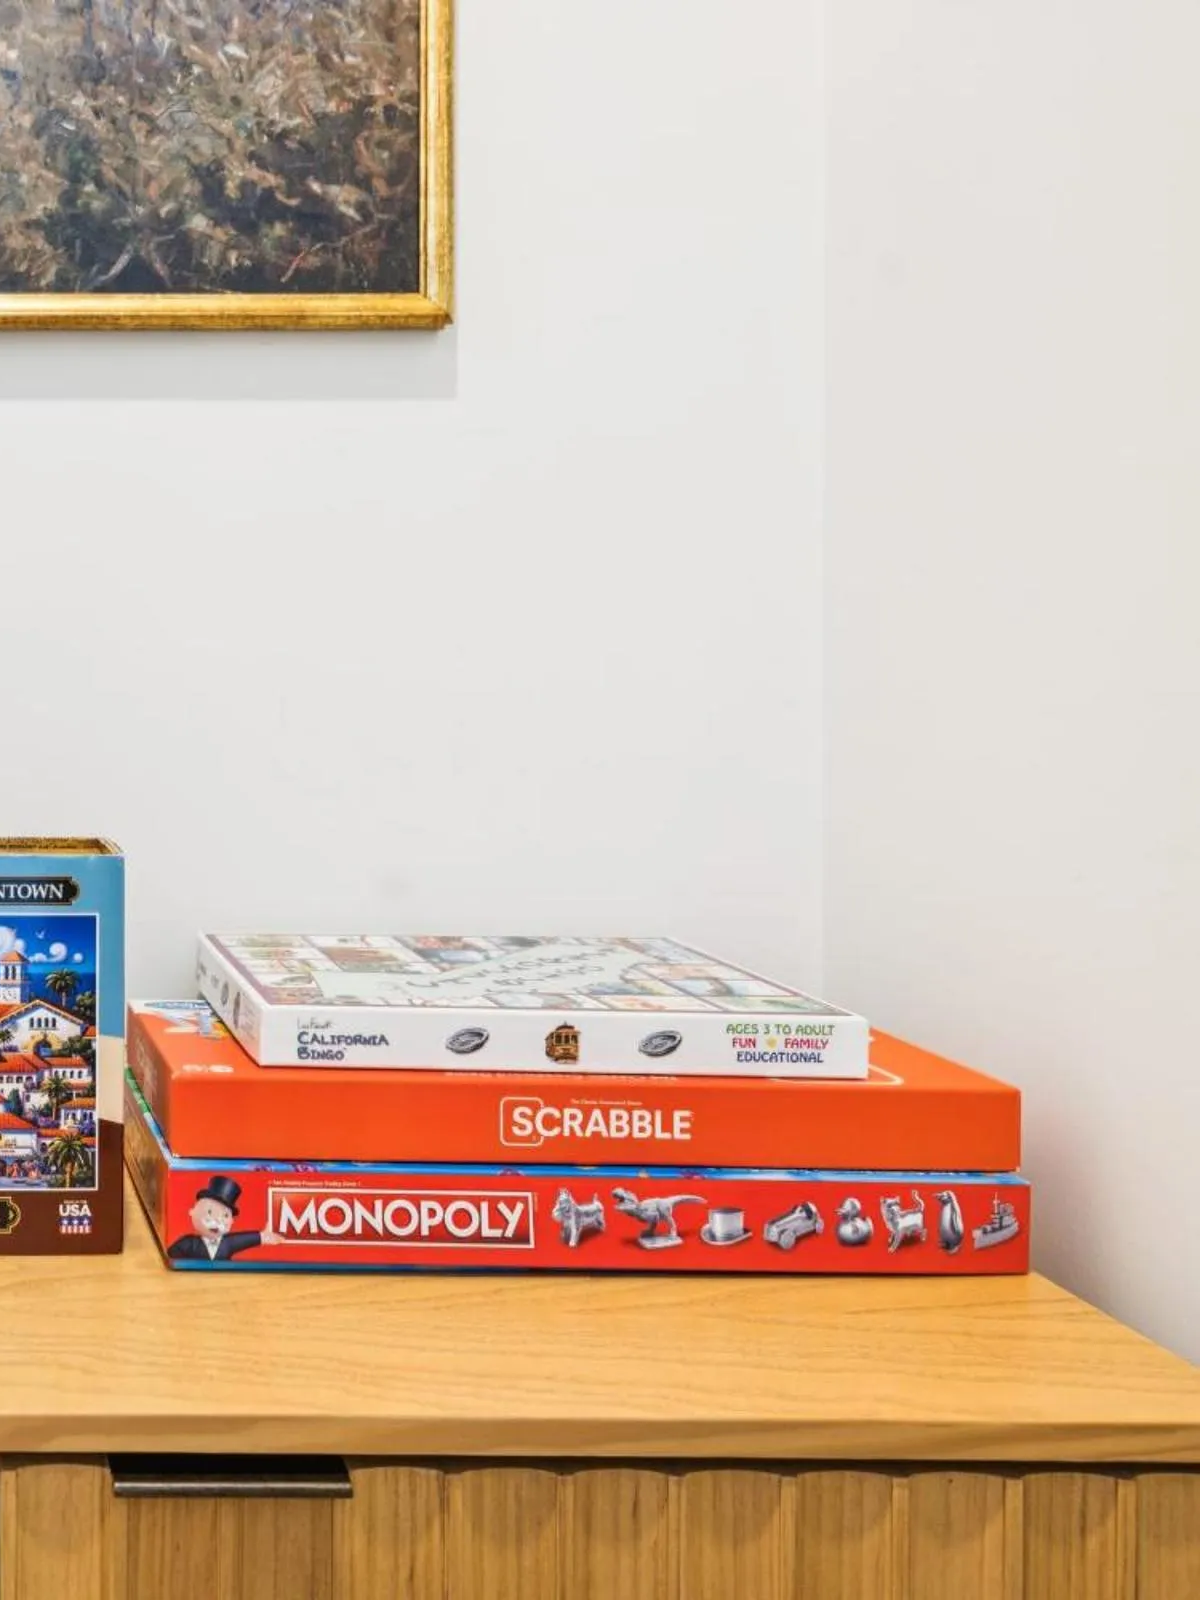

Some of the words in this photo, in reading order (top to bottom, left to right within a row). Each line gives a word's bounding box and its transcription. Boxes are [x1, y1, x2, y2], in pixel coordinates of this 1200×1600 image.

[726, 1023, 759, 1034] AGES
[763, 1023, 771, 1035] 3
[774, 1023, 792, 1035] TO
[795, 1024, 835, 1036] ADULT
[297, 1031, 390, 1046] CALIFORNIA
[732, 1038, 756, 1049] FUN
[784, 1038, 829, 1049] FAMILY
[297, 1046, 346, 1061] BINGO
[736, 1051, 824, 1063] EDUCATIONAL
[511, 1106, 692, 1140] SCRABBLE
[59, 1204, 92, 1217] USA
[279, 1197, 523, 1238] MONOPOLY
